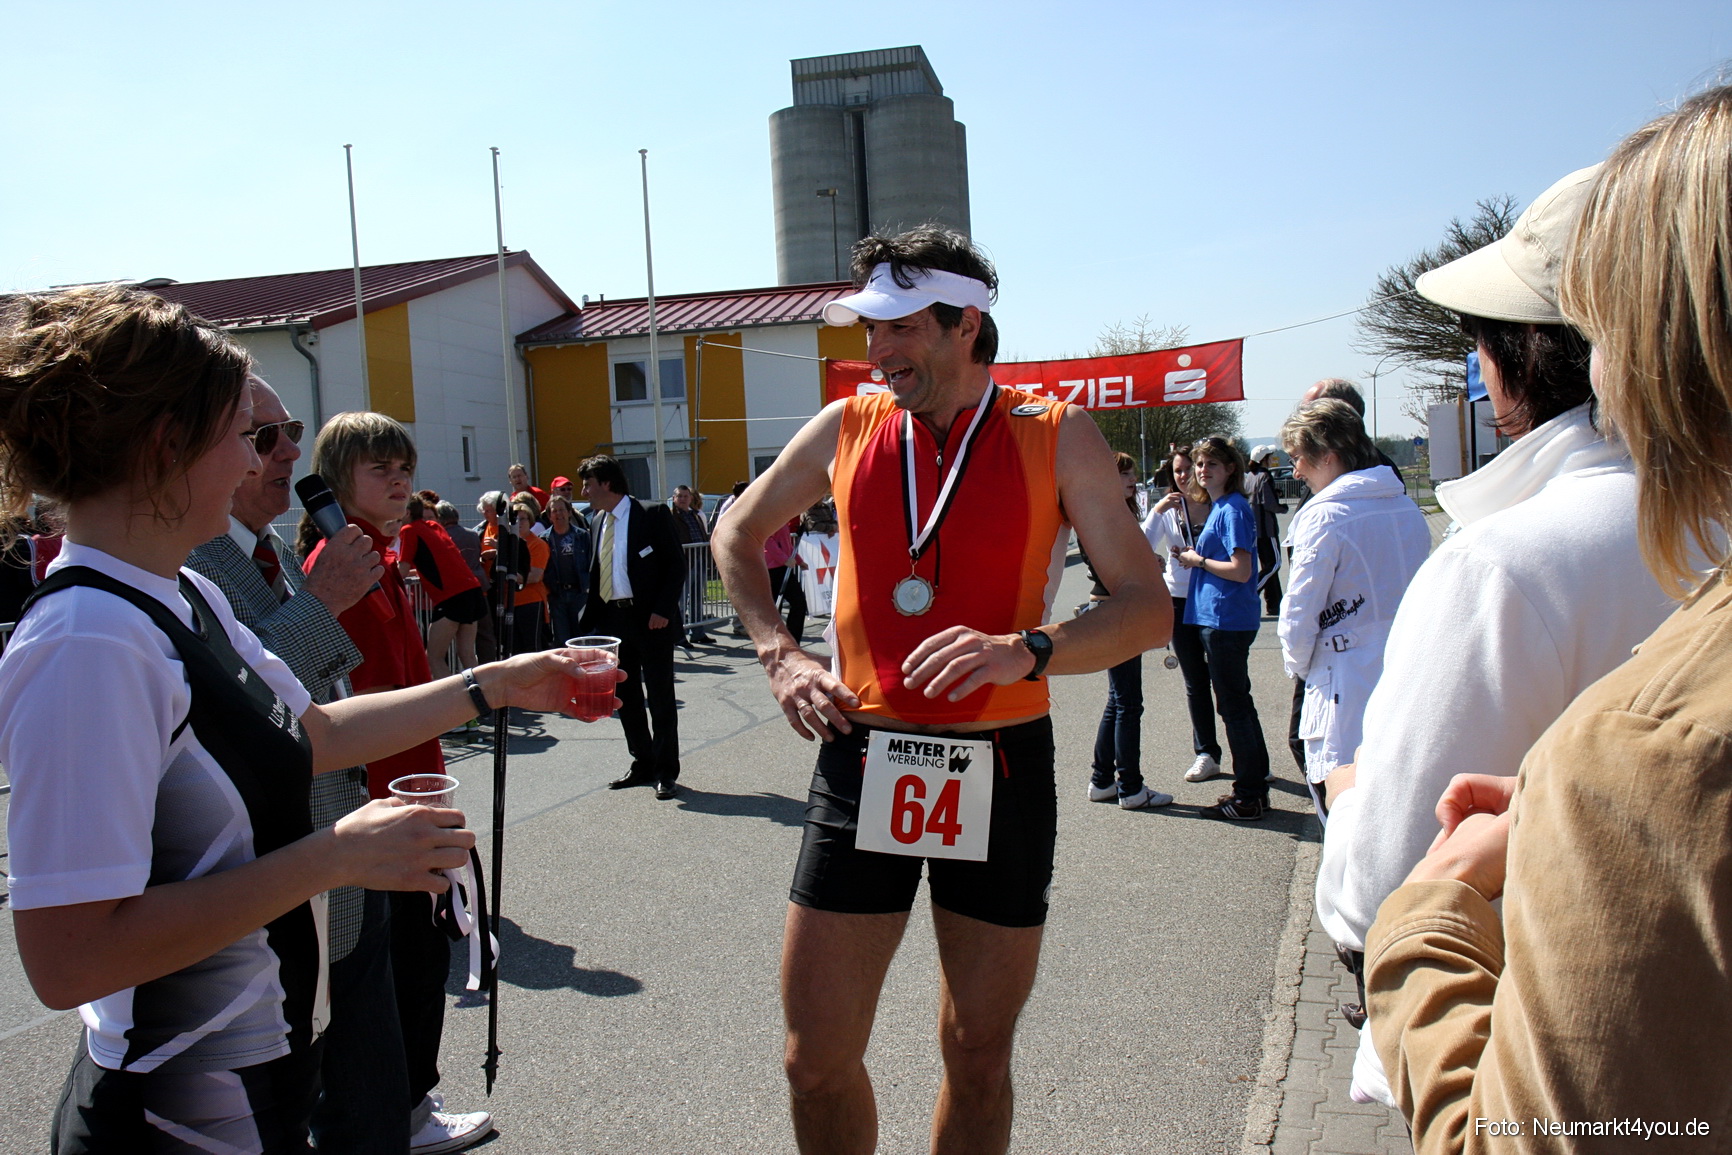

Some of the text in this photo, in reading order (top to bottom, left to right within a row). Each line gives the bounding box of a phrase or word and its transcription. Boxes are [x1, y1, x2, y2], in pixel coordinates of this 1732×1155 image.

[887, 738, 946, 758] MEYER
[887, 752, 945, 769] WERBUNG
[890, 774, 962, 846] 64
